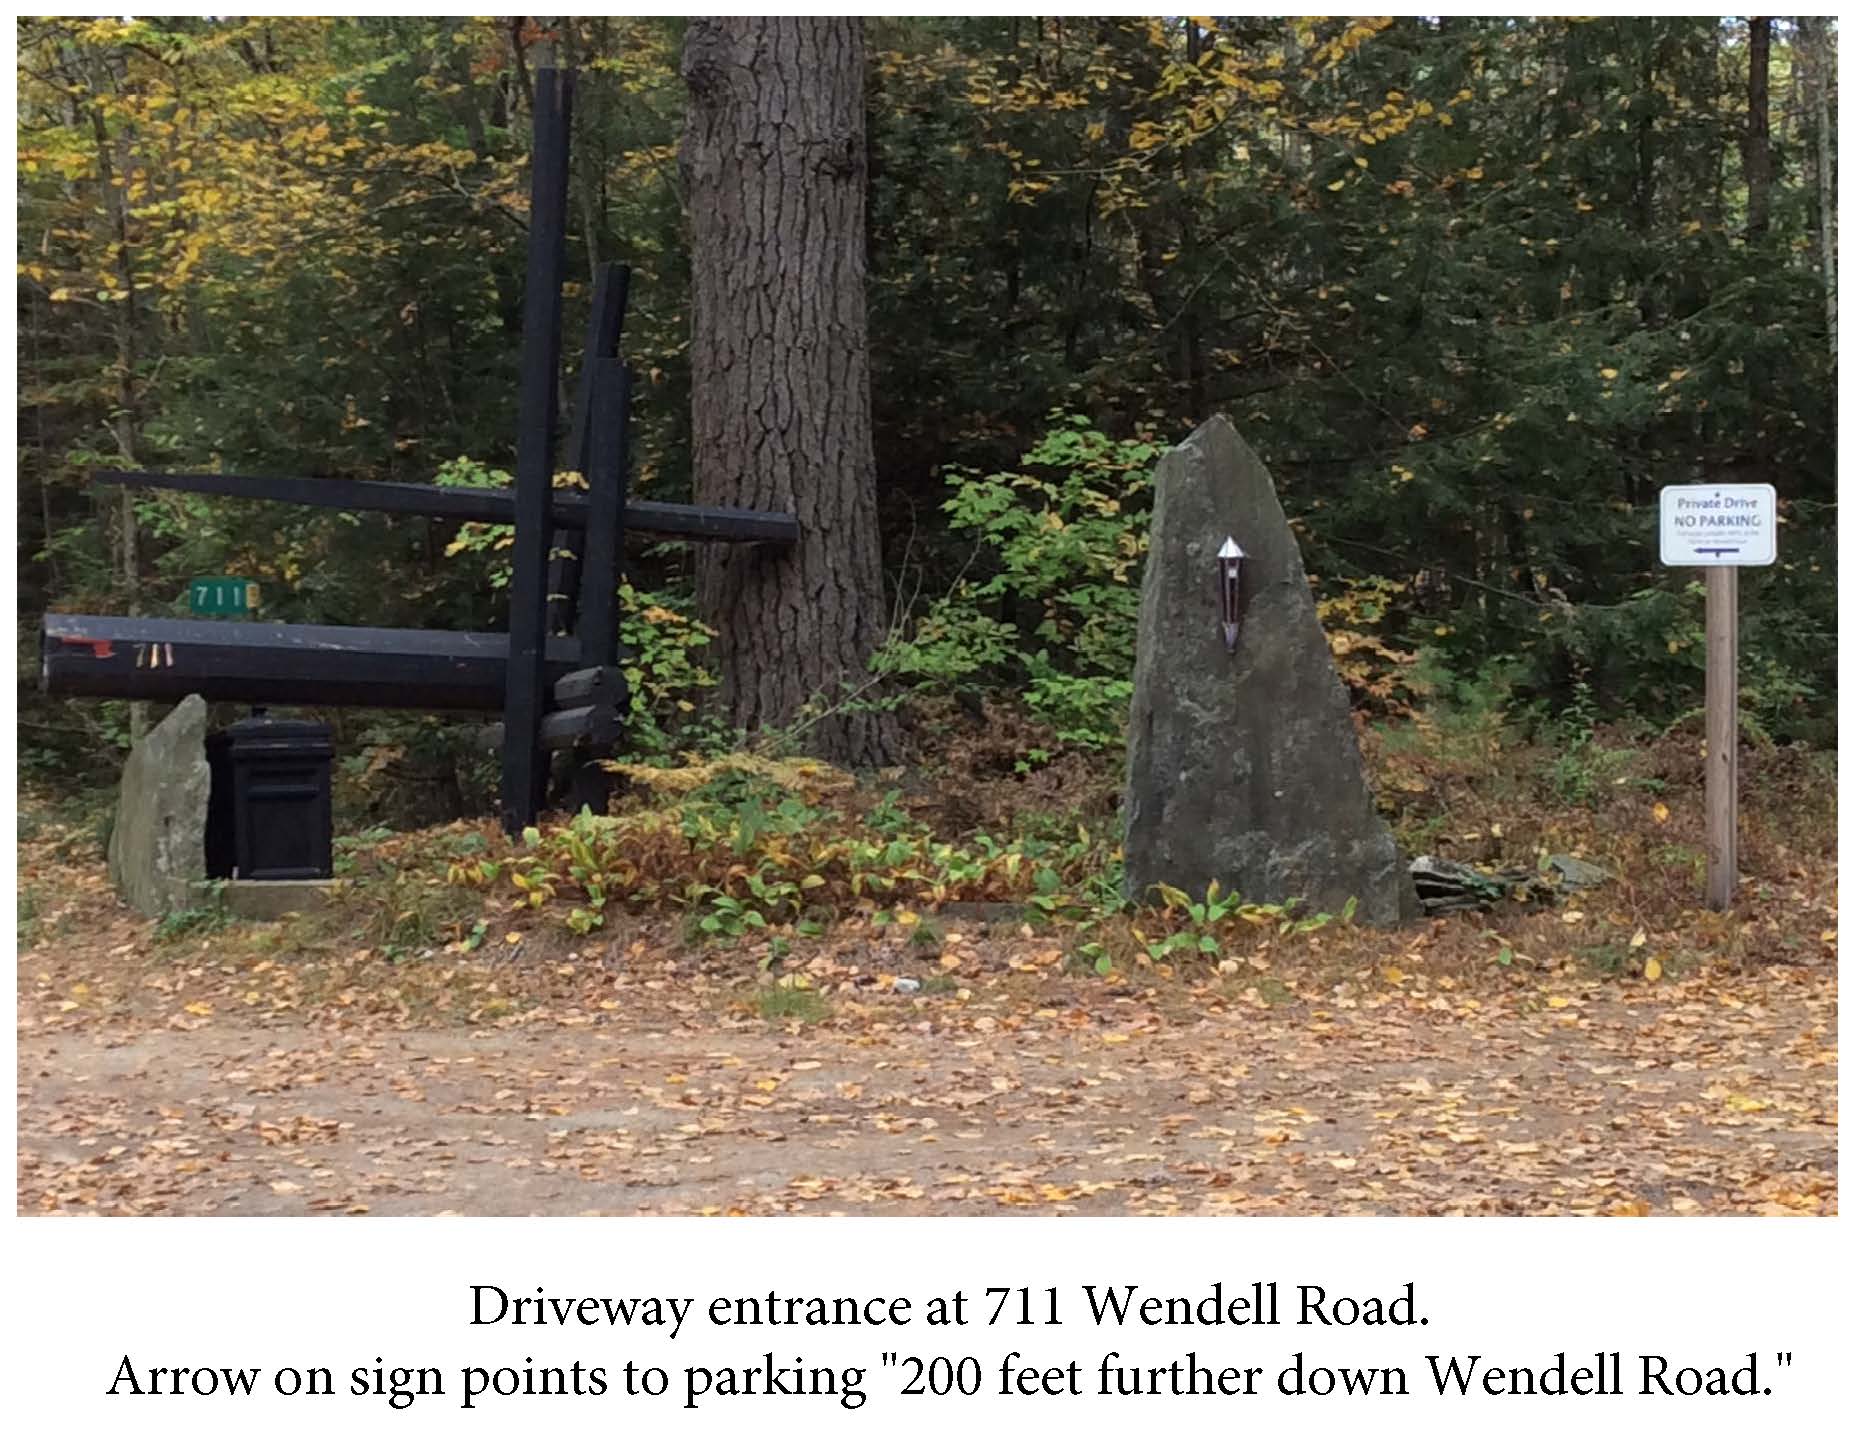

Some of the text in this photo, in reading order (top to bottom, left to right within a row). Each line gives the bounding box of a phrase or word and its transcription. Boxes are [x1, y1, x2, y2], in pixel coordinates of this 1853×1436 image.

[1677, 497, 1758, 509] Private Drive
[1674, 515, 1762, 527] NO PARKING
[196, 586, 240, 606] 711
[132, 643, 174, 668] 711
